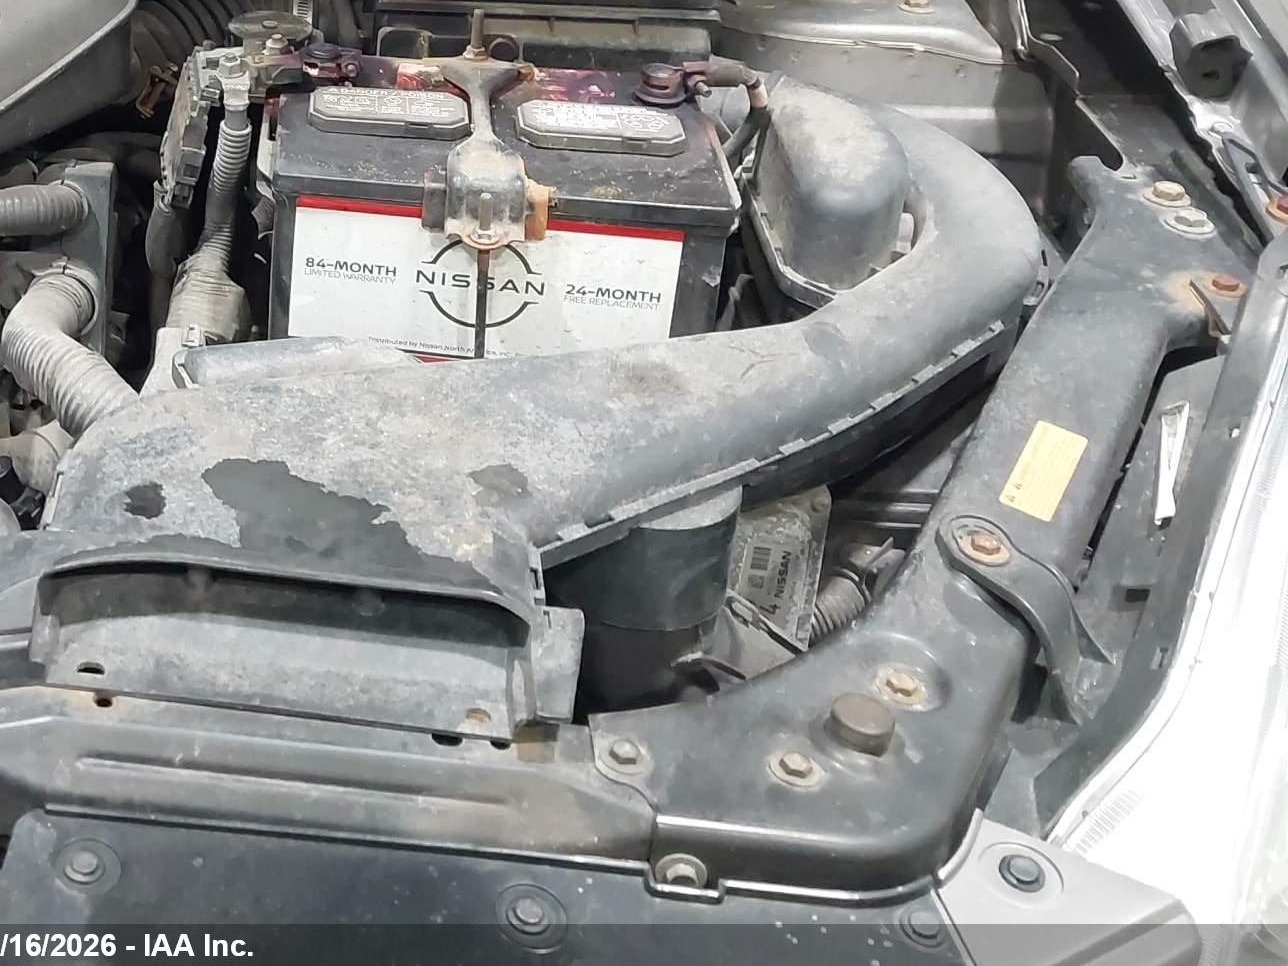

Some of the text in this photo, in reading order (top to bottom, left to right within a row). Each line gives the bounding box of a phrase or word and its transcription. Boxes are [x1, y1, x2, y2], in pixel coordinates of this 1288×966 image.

[304, 268, 396, 284] LIMITED WARRANTY
[305, 257, 397, 277] 84-MONTH
[415, 269, 545, 296] NISSAN
[564, 295, 660, 311] FREE REPLACEMENT
[565, 284, 662, 303] 24-MONTH
[774, 551, 792, 598] NISSAN
